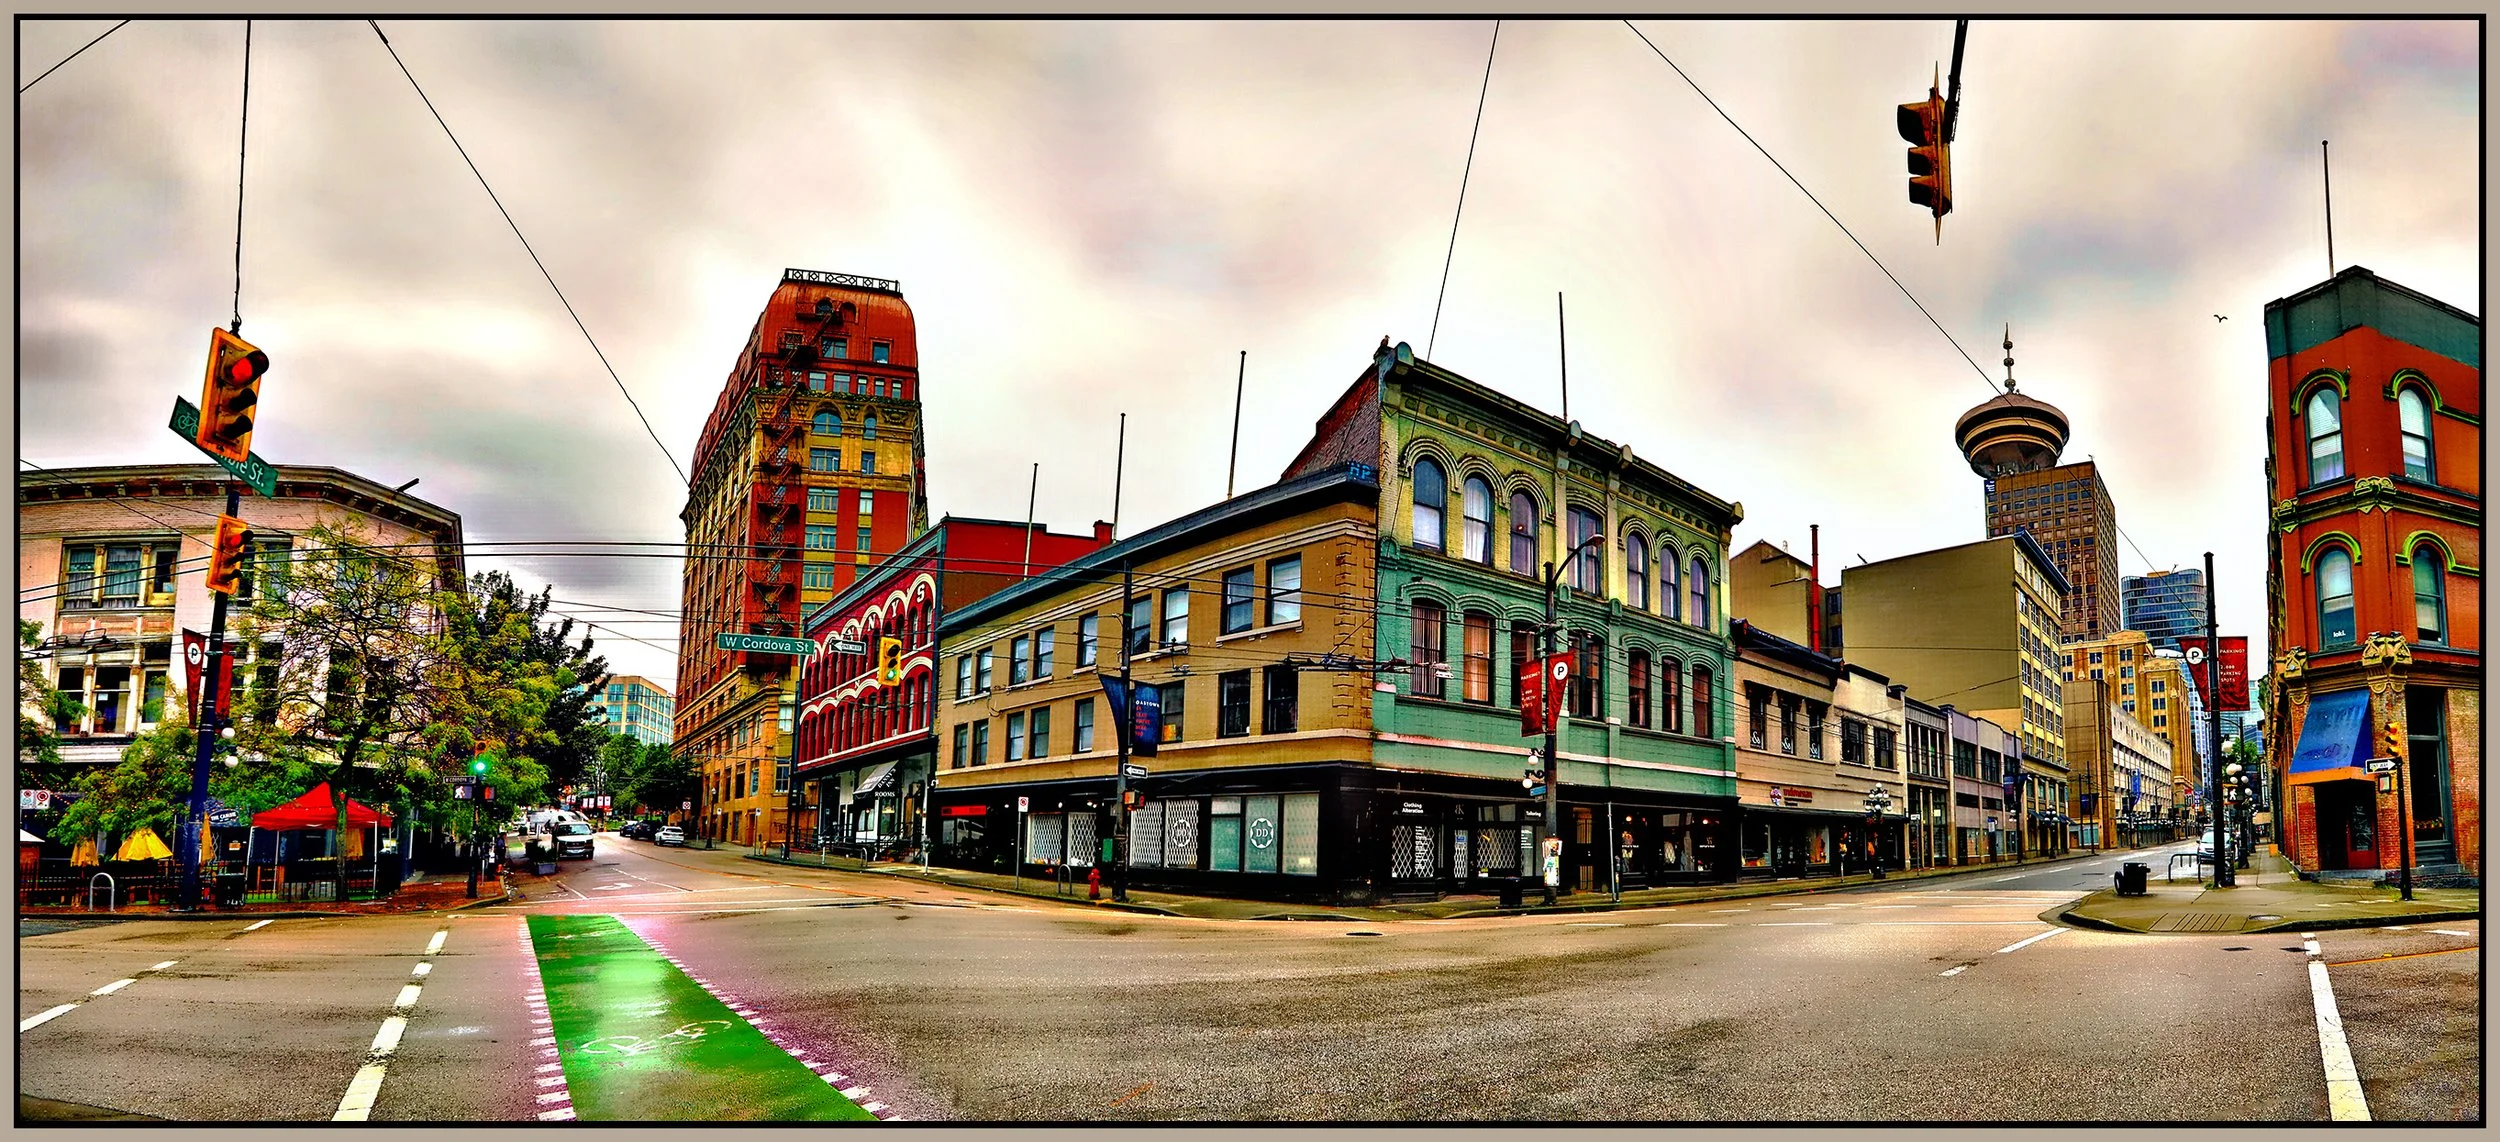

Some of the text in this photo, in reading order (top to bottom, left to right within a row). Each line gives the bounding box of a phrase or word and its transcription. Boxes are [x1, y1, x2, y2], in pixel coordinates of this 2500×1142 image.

[249, 462, 264, 488] St.
[725, 636, 809, 653] W Cordova St
[191, 647, 198, 658] P
[2191, 651, 2199, 660] P
[1557, 666, 1565, 676] P
[1255, 828, 1269, 838] DD
